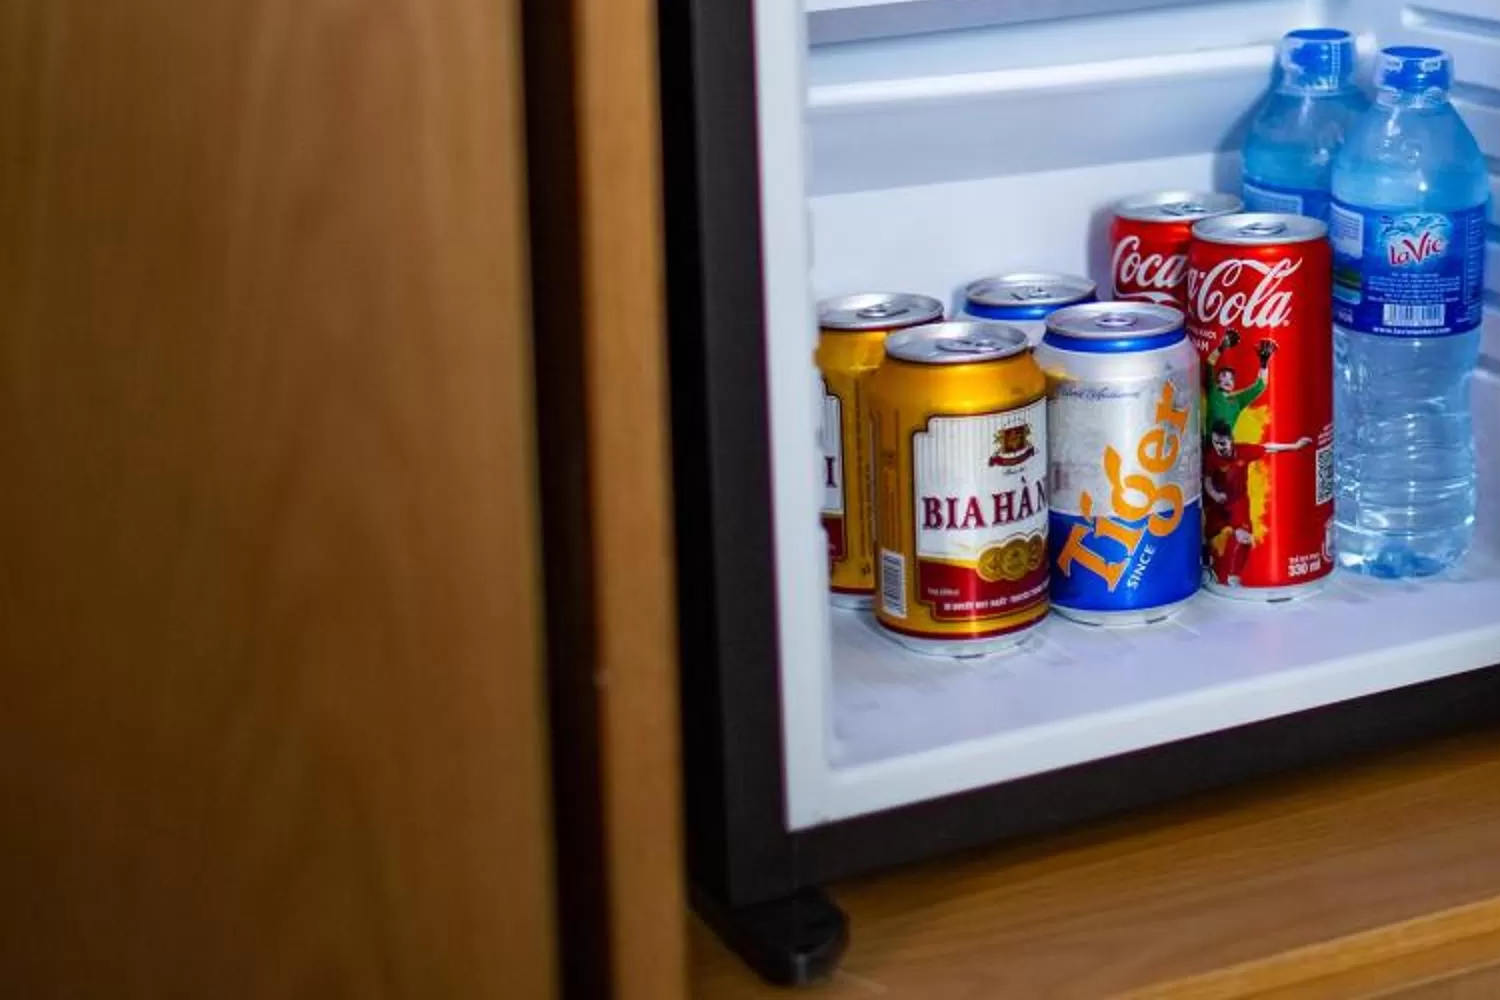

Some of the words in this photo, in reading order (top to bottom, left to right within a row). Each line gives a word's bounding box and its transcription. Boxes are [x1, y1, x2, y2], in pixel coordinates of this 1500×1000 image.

[1057, 379, 1190, 593] Tiger
[922, 496, 986, 530] BIA
[1126, 545, 1155, 589] SINCE
